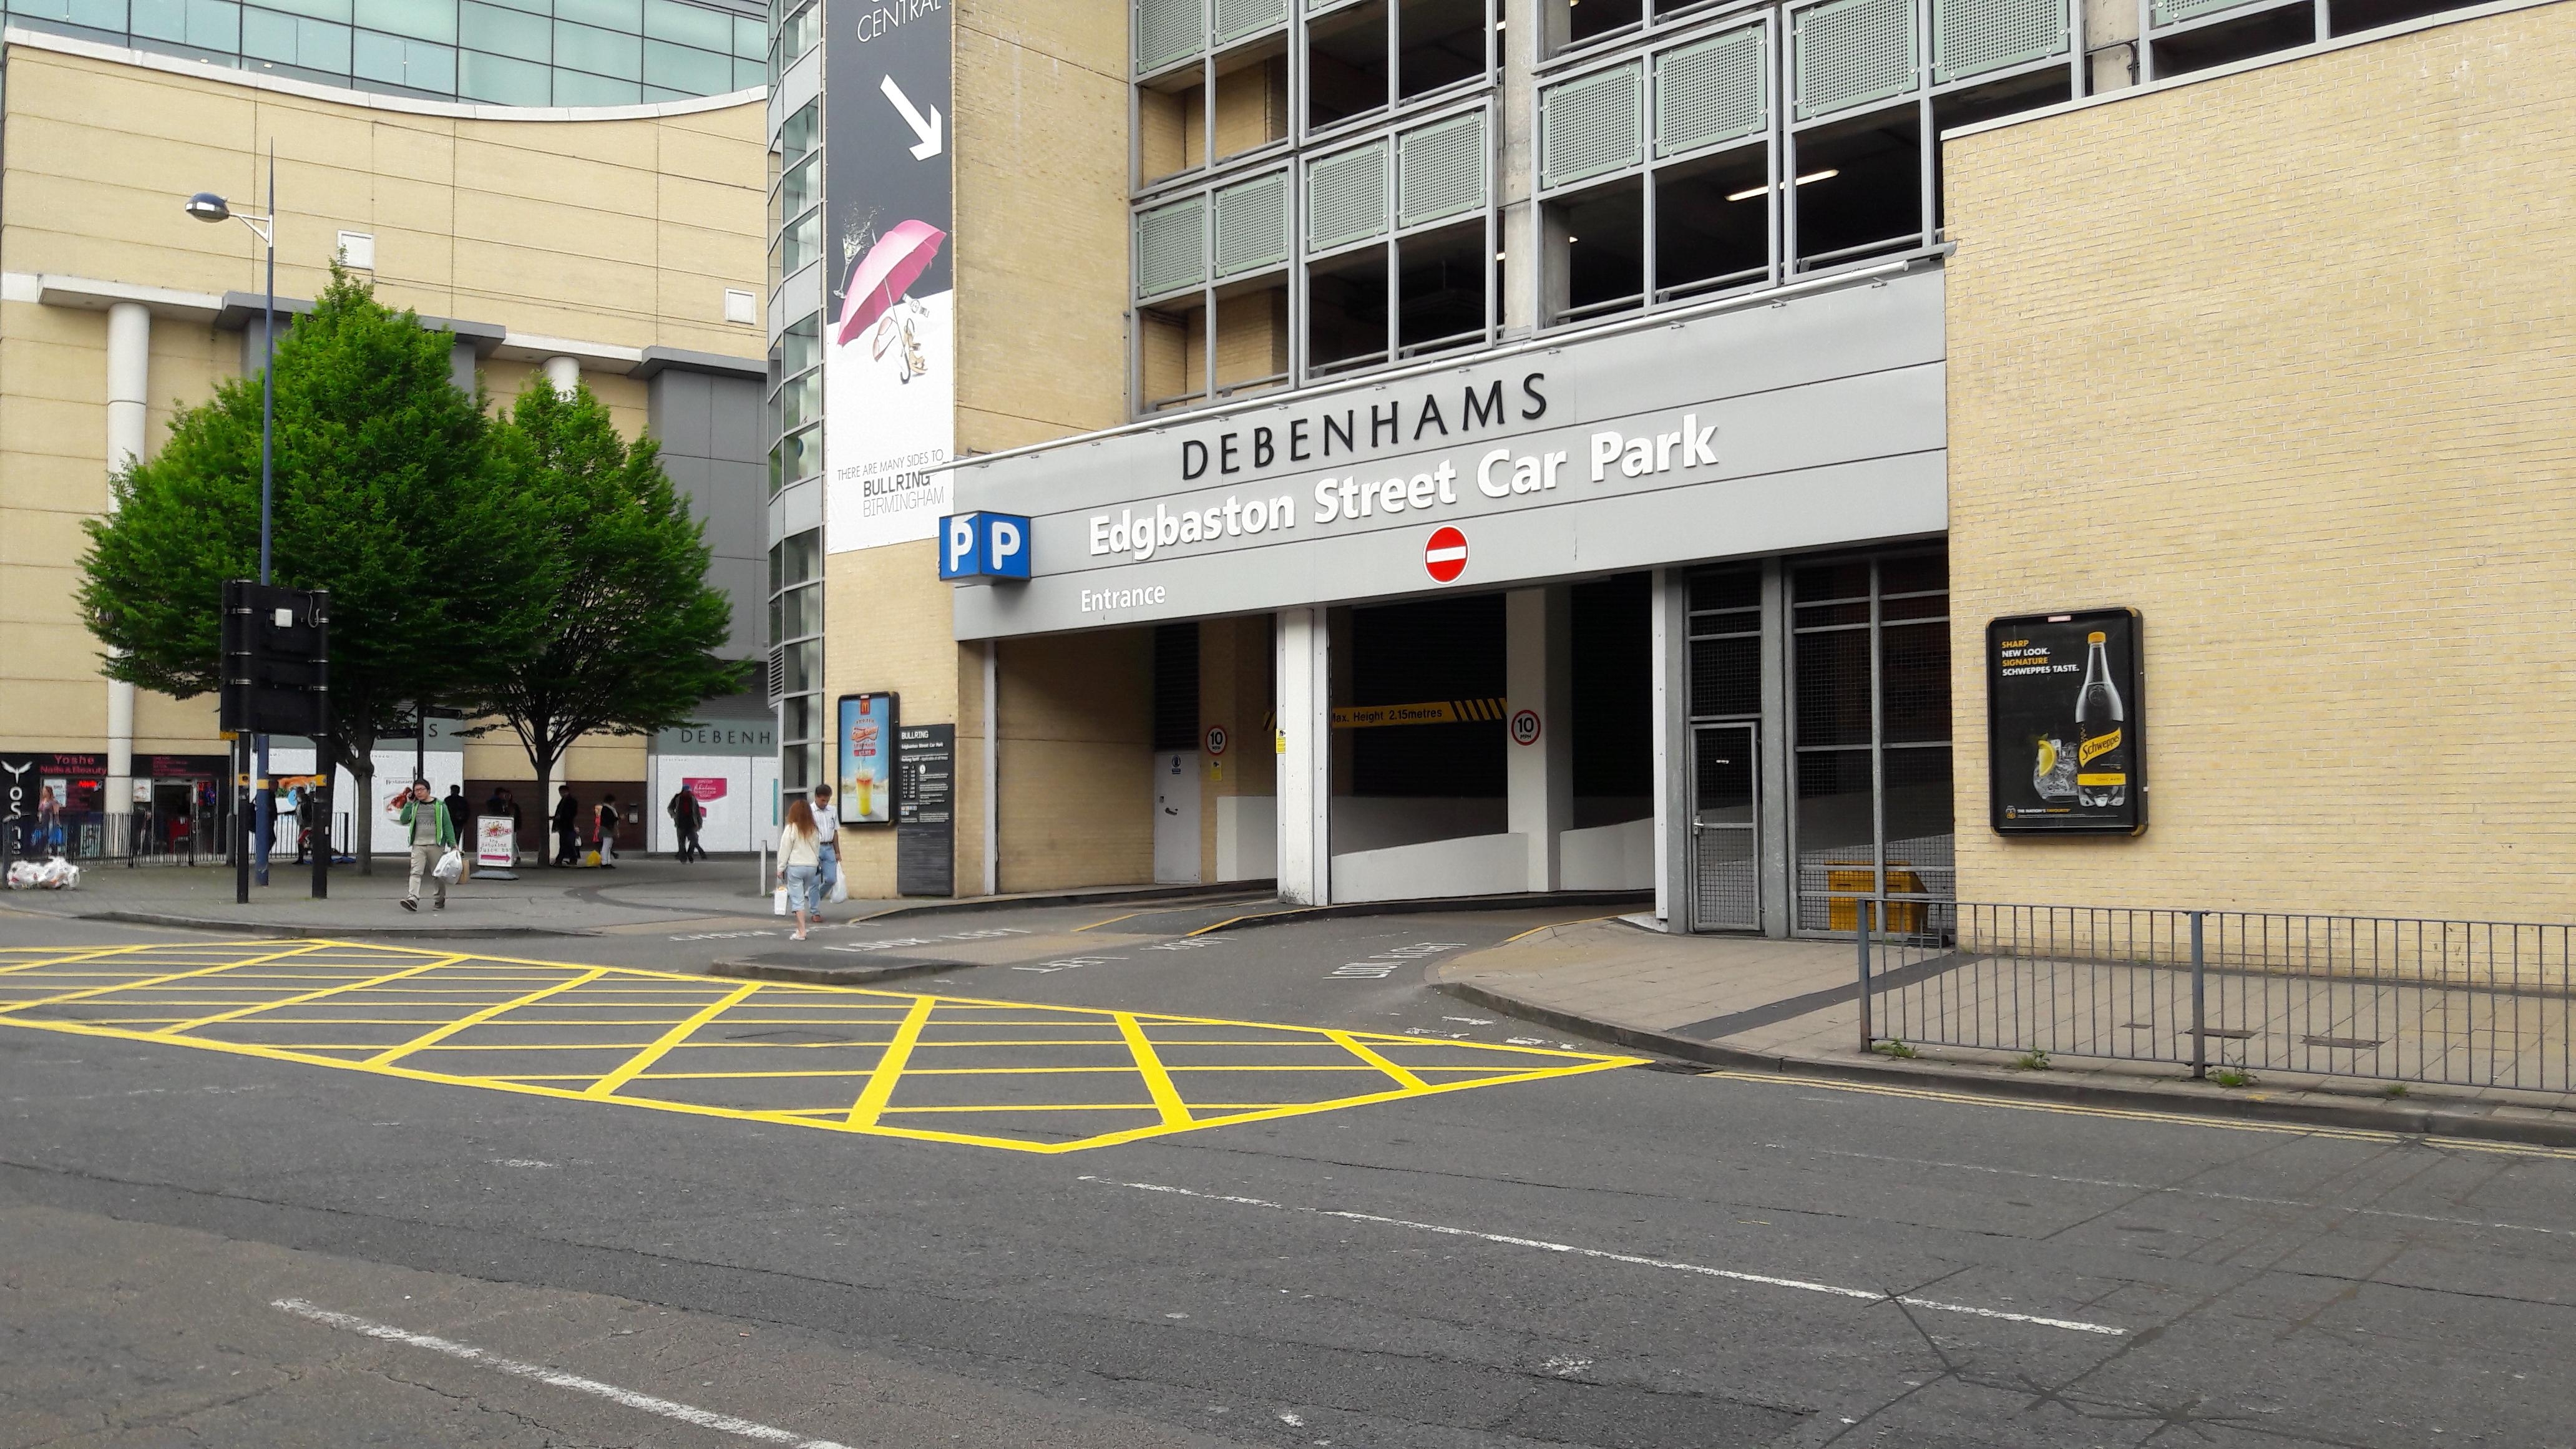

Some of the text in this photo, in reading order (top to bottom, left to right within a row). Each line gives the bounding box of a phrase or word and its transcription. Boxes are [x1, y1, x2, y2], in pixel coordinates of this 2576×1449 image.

[1181, 372, 1547, 481] DEBENHAMS
[837, 449, 944, 481] THERE ARE MANY SIDES TO
[863, 471, 931, 498] BULLRING
[1090, 413, 1719, 561] Edgbaston Street Car Park
[863, 485, 944, 517] BIRMINGHAM
[950, 519, 973, 573] P
[992, 521, 1021, 570] P
[1081, 585, 1166, 613] Entrance
[2001, 639, 2029, 649] SHARP
[2001, 647, 2051, 658] NEW LOOK.
[2001, 656, 2049, 667] SIGNATURE
[2002, 663, 2080, 676] SCHWEPPES TASTE.
[1353, 711, 1383, 723] Height
[1517, 717, 1534, 733] 10
[680, 728, 778, 744] DEBENH
[901, 730, 929, 740] BULLRING
[1210, 731, 1223, 745] 10
[2082, 734, 2120, 761] Schweppes
[54, 754, 95, 765] Yoshe
[1322, 942, 1468, 979] LOOK RIGHT
